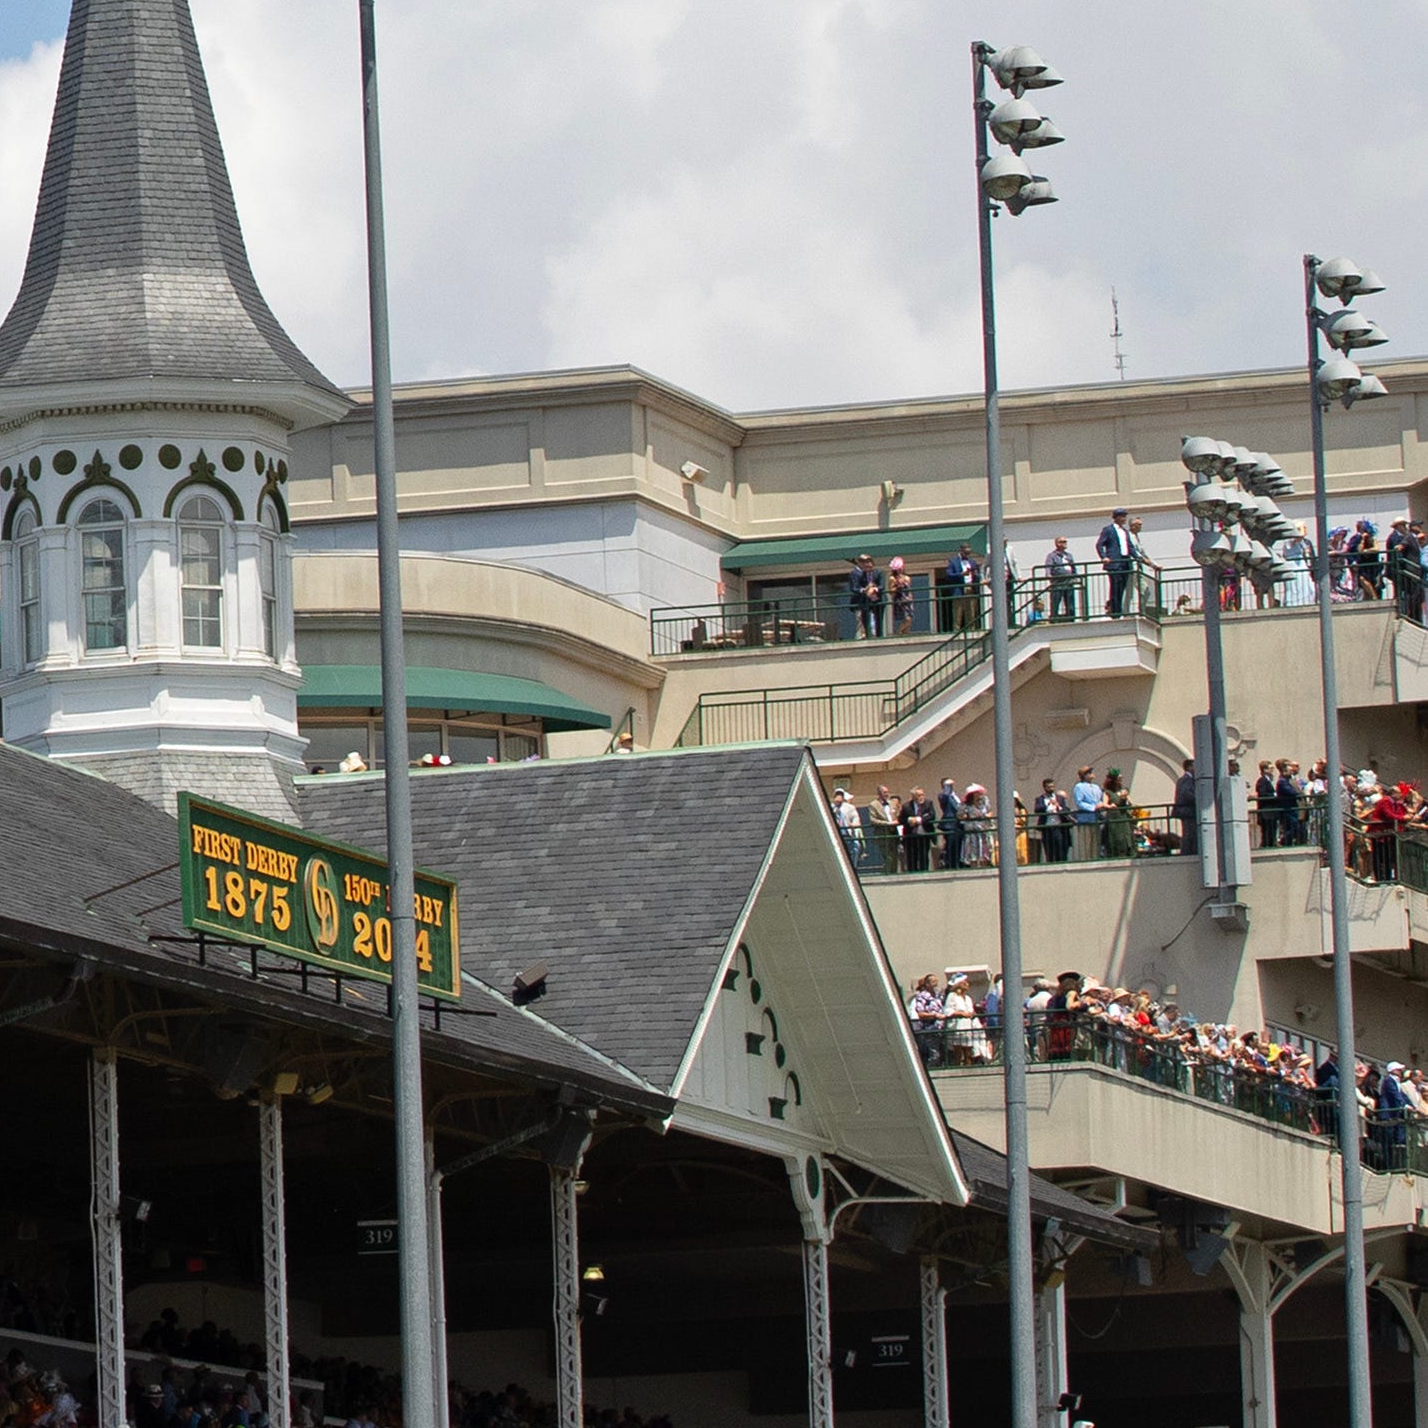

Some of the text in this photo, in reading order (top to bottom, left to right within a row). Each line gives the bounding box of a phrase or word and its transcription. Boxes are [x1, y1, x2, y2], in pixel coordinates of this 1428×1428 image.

[192, 824, 298, 884] FIRST DERBY
[205, 866, 292, 931] 1875
[344, 873, 443, 927] 150TH RBY
[353, 911, 433, 972] 204
[365, 1228, 393, 1244] 319
[879, 1344, 903, 1357] 319
